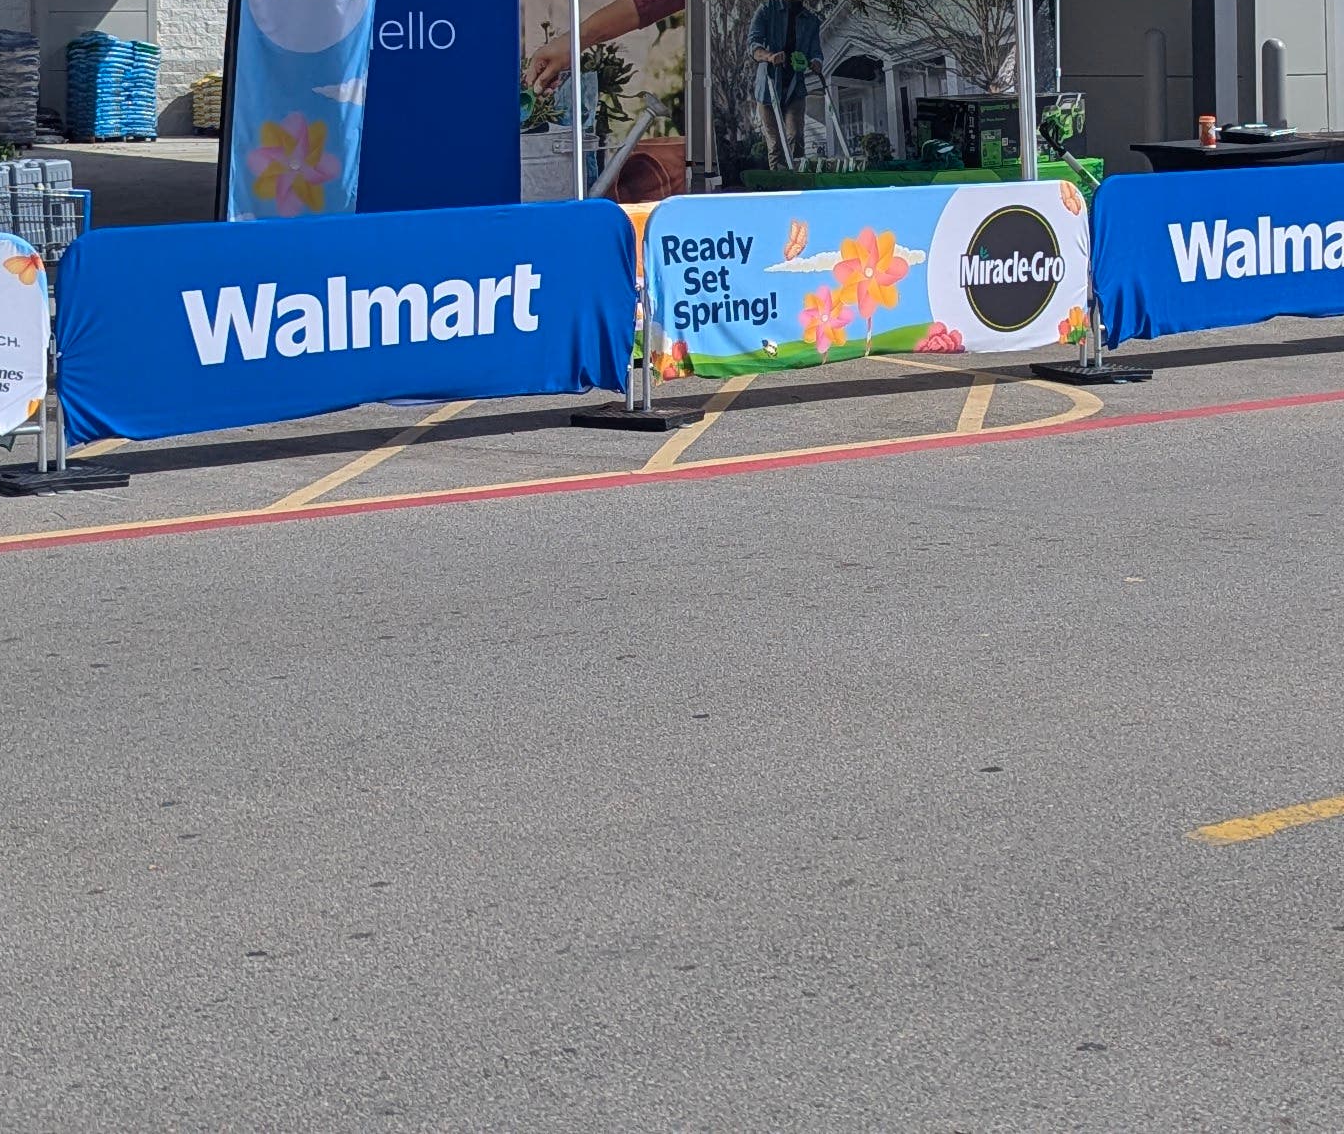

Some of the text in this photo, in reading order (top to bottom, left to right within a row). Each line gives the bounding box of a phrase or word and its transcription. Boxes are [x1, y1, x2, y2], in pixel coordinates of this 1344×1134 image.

[370, 11, 456, 51] ello
[661, 230, 754, 267] Ready
[683, 266, 730, 295] Set
[960, 250, 1065, 288] Miracle-Gro
[181, 263, 542, 366] Walmart
[673, 291, 778, 333] Spring!
